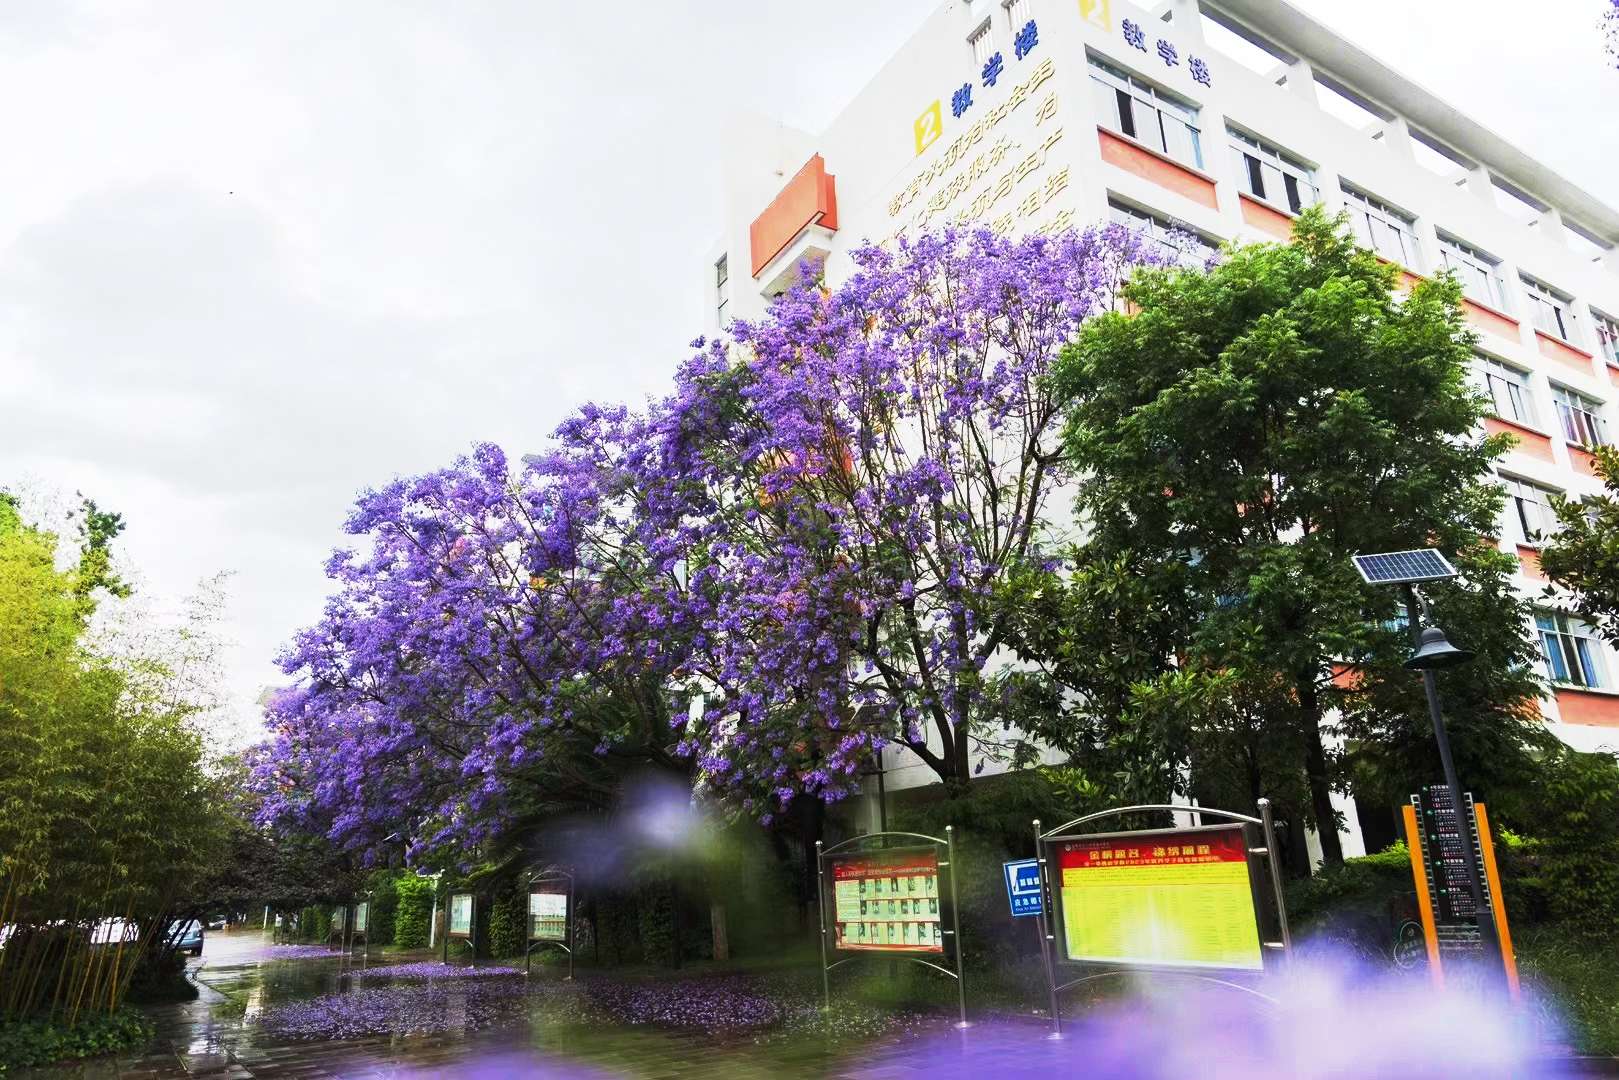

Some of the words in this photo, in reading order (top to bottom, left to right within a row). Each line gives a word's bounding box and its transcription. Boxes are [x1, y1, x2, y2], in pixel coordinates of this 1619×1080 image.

[952, 20, 1038, 118] 教学楼
[1122, 18, 1211, 88] 教学楼
